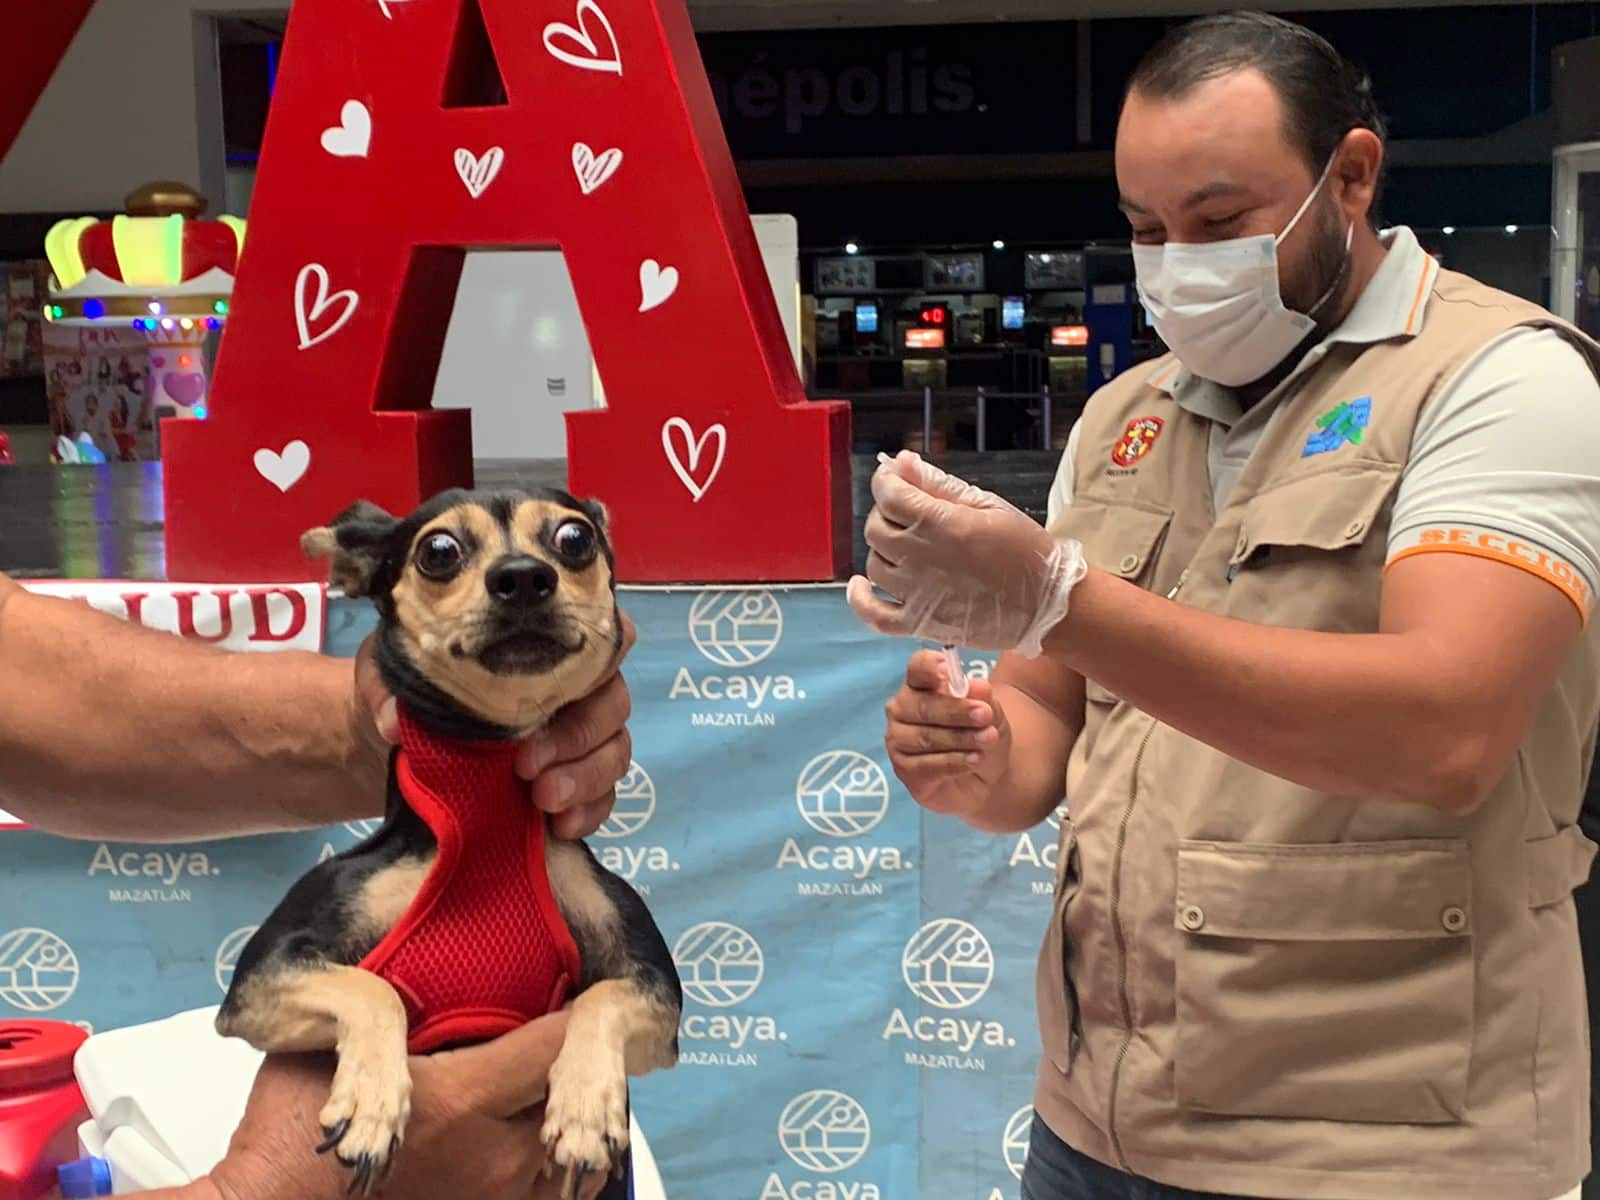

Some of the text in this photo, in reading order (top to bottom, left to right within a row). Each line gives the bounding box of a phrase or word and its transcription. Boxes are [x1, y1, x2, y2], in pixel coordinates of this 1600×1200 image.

[668, 667, 806, 709] Acaya.
[88, 843, 220, 885] Acaya.
[592, 845, 681, 880] aya.
[776, 838, 913, 879] Acaya.
[677, 1014, 788, 1048] caya.
[882, 1008, 1017, 1052] Acaya.
